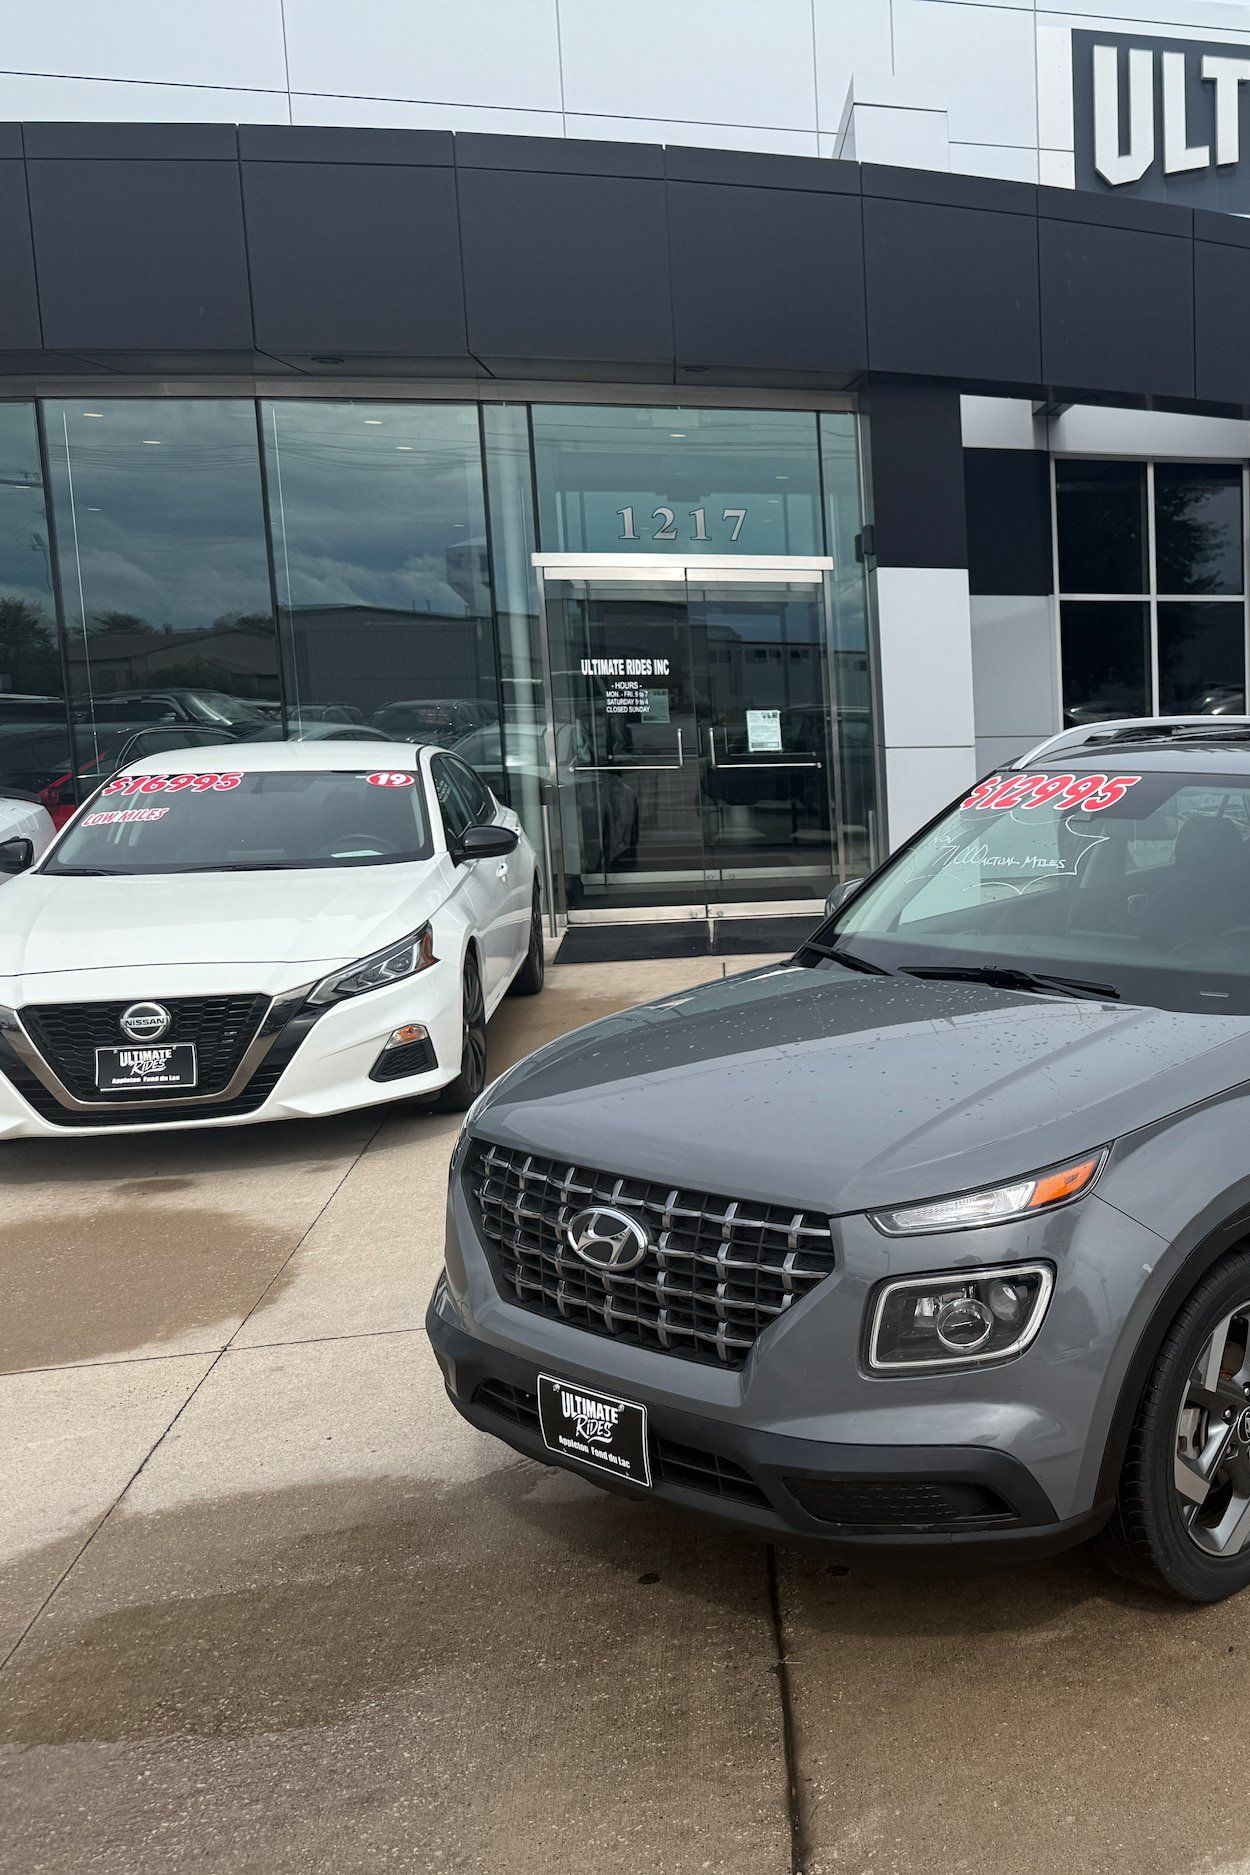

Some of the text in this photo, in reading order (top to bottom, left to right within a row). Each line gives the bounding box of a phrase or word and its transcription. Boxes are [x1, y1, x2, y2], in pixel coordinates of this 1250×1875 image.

[617, 506, 747, 541] 1217
[581, 659, 670, 675] ULTIMATE RIDES INC
[615, 682, 639, 690] HOURS
[101, 772, 244, 796] $16995
[377, 773, 407, 785] 19
[959, 774, 1142, 812] $12995
[82, 807, 170, 827] LOW MILES
[1021, 856, 1066, 868] MILES
[125, 1018, 164, 1026] NISSAN
[120, 1049, 172, 1067] ULTIMATE
[561, 1391, 618, 1424] ULTIMATE
[558, 1435, 631, 1469] Appleton Fond du Lac
